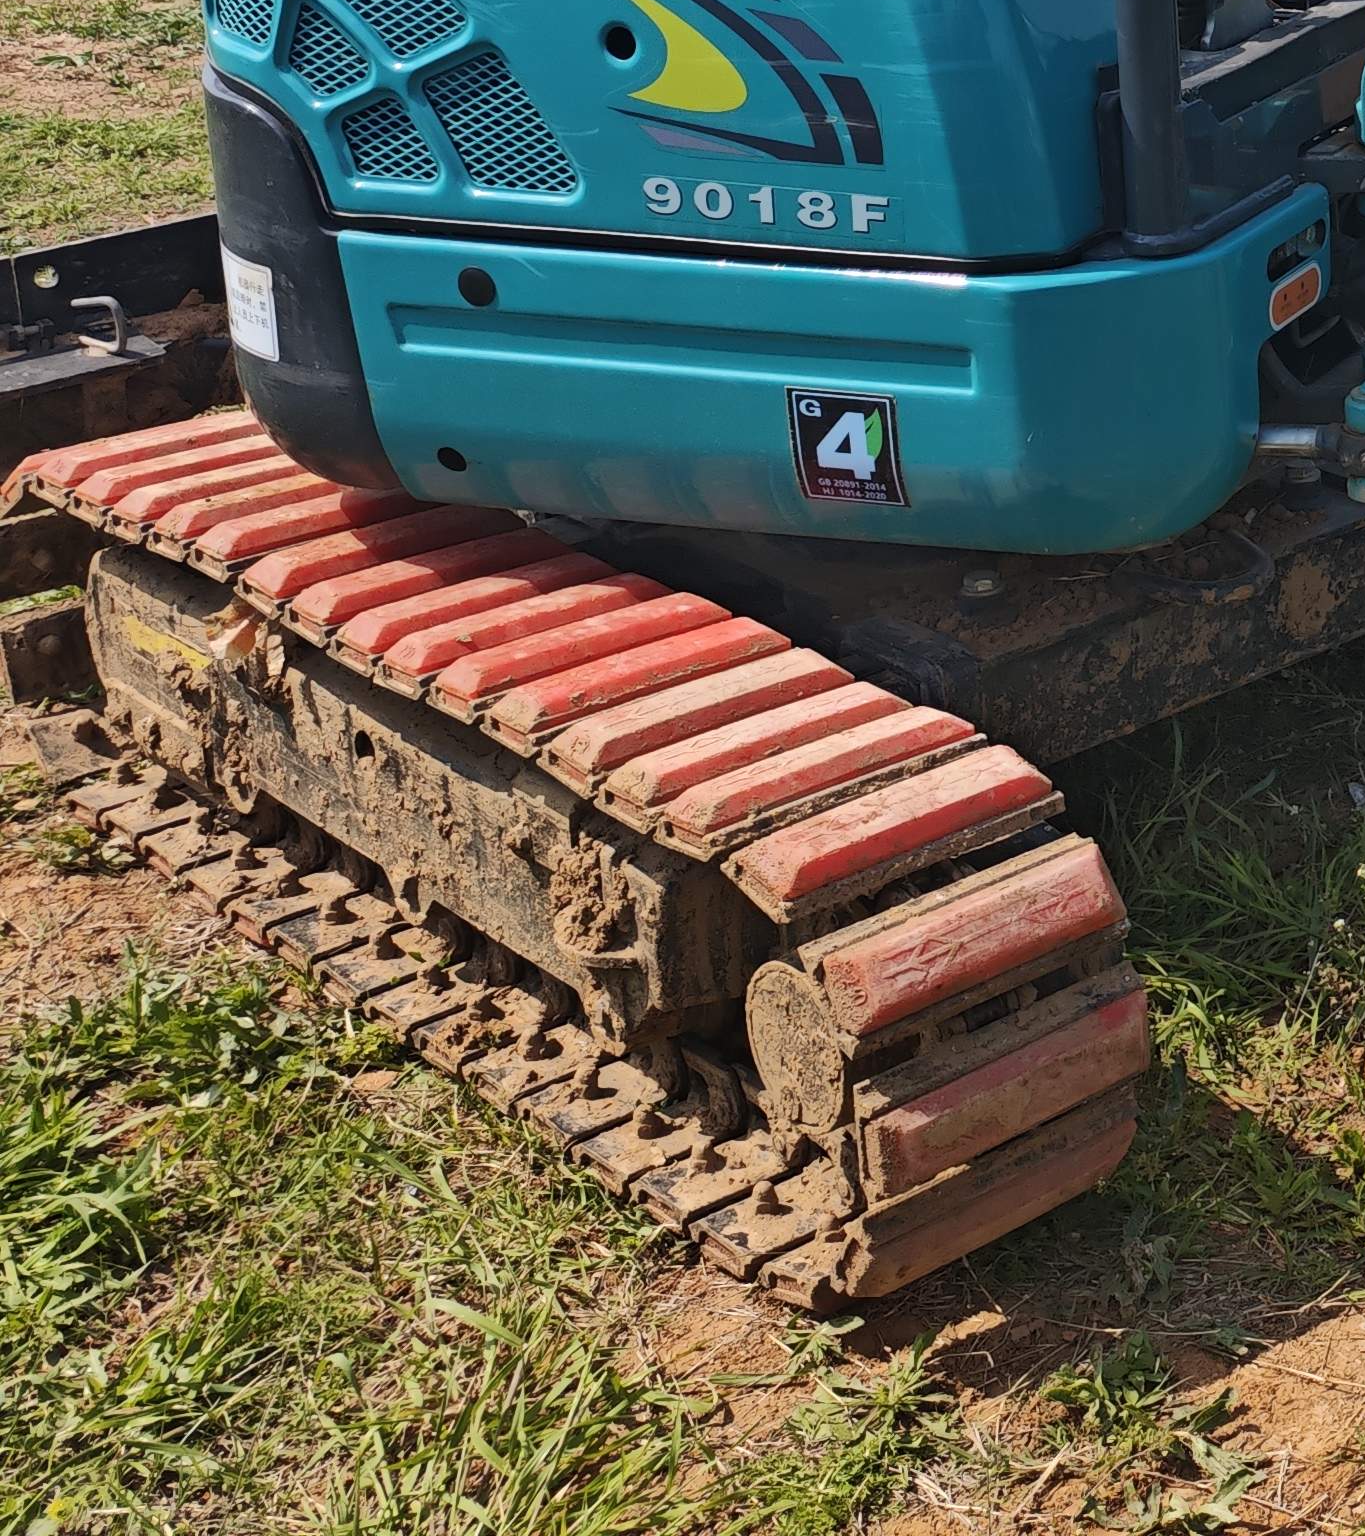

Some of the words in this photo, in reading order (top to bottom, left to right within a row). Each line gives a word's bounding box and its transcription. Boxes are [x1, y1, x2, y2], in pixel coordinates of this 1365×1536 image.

[642, 177, 890, 234] 9018F
[799, 399, 822, 418] G
[816, 411, 876, 480] 4
[818, 477, 831, 486] GB
[833, 478, 887, 492] 20891-2014
[822, 487, 835, 495] HJ
[840, 488, 887, 501] 1014-2020
